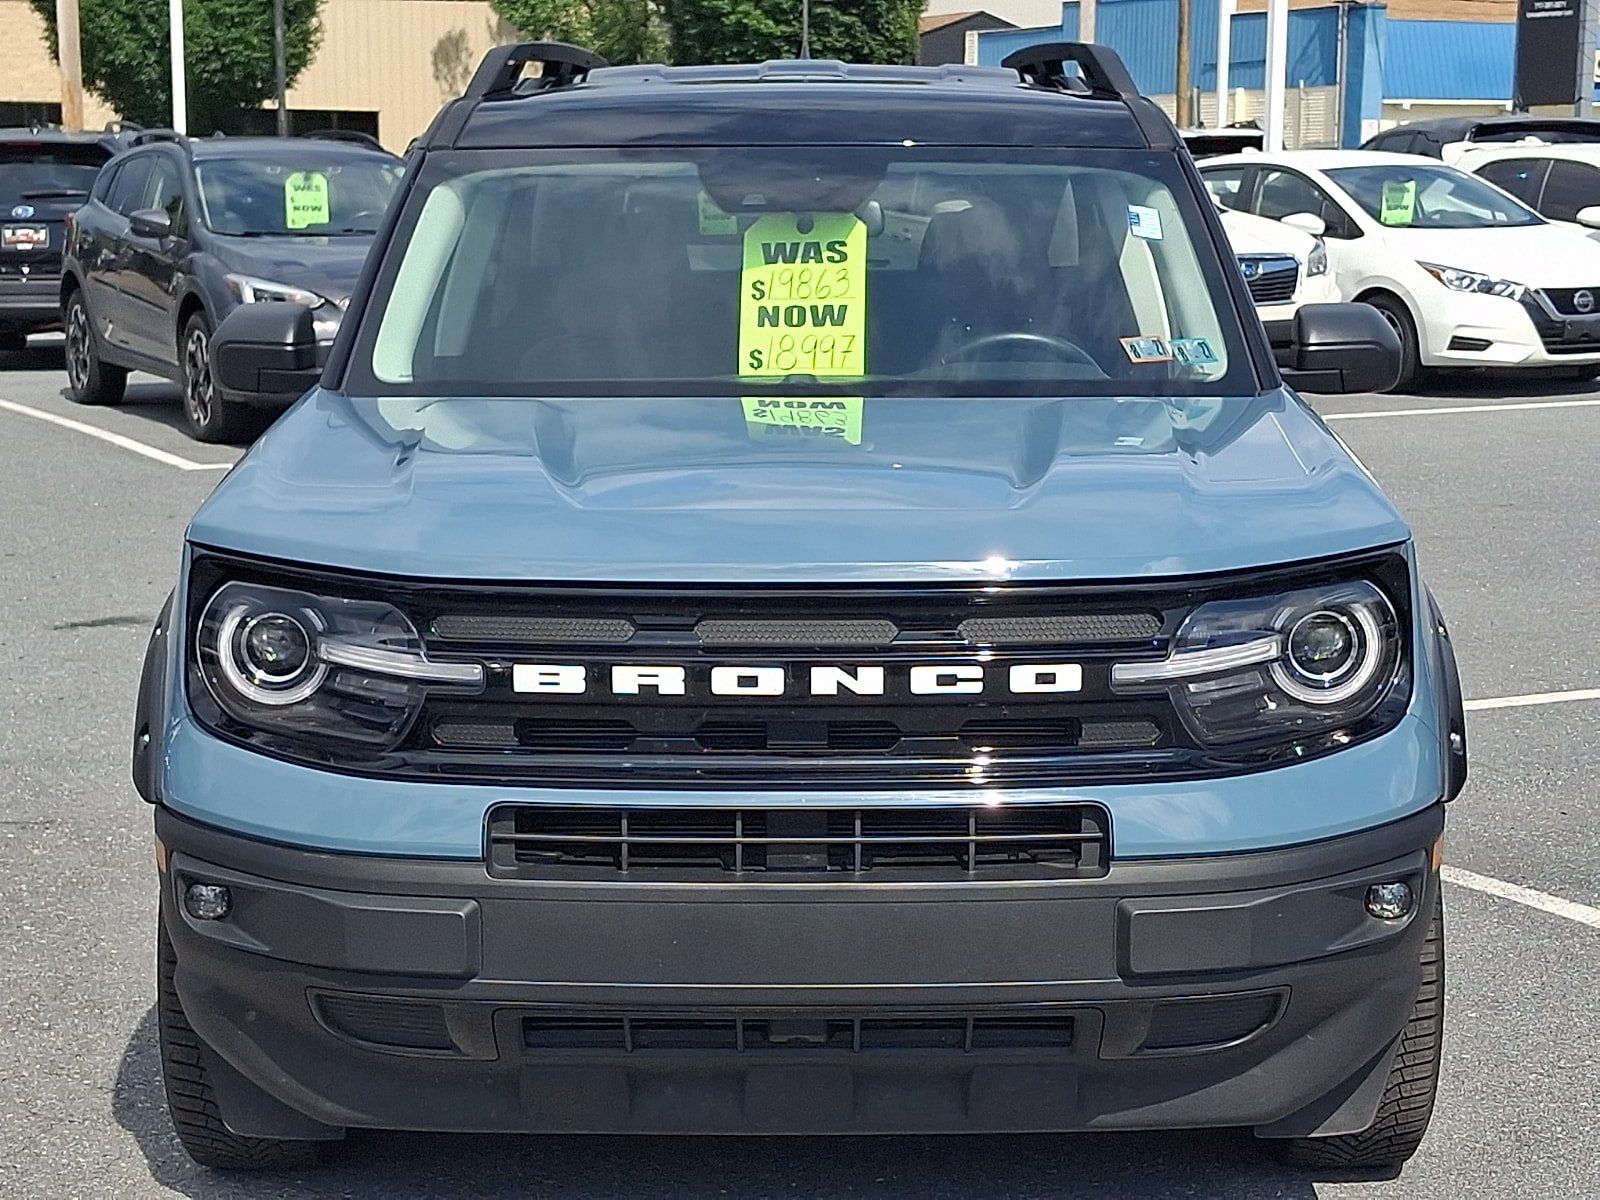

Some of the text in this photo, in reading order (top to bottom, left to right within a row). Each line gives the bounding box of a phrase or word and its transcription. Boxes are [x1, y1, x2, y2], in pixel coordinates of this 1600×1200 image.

[761, 240, 848, 265] WAS
[757, 305, 848, 328] NOW
[512, 663, 1083, 696] BRONCO
